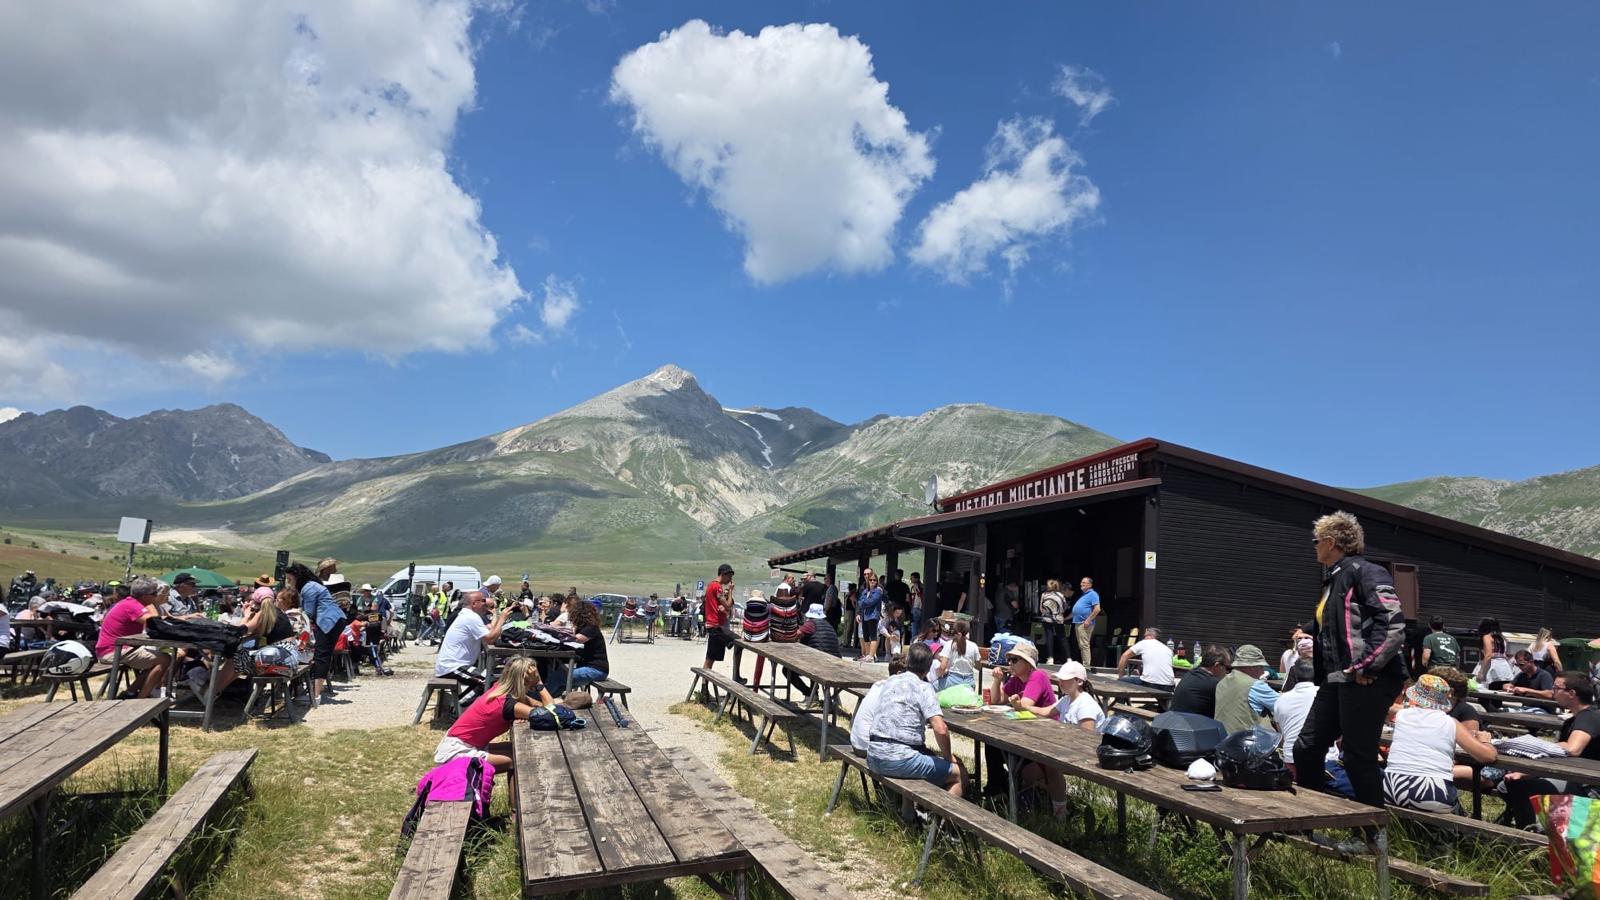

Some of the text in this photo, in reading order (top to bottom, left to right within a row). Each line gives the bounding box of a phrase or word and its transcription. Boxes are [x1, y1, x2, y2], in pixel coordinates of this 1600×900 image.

[1089, 461, 1109, 473] CARNI
[1009, 468, 1086, 503] MUCCIANTE
[1089, 472, 1125, 488] FORMAGGI
